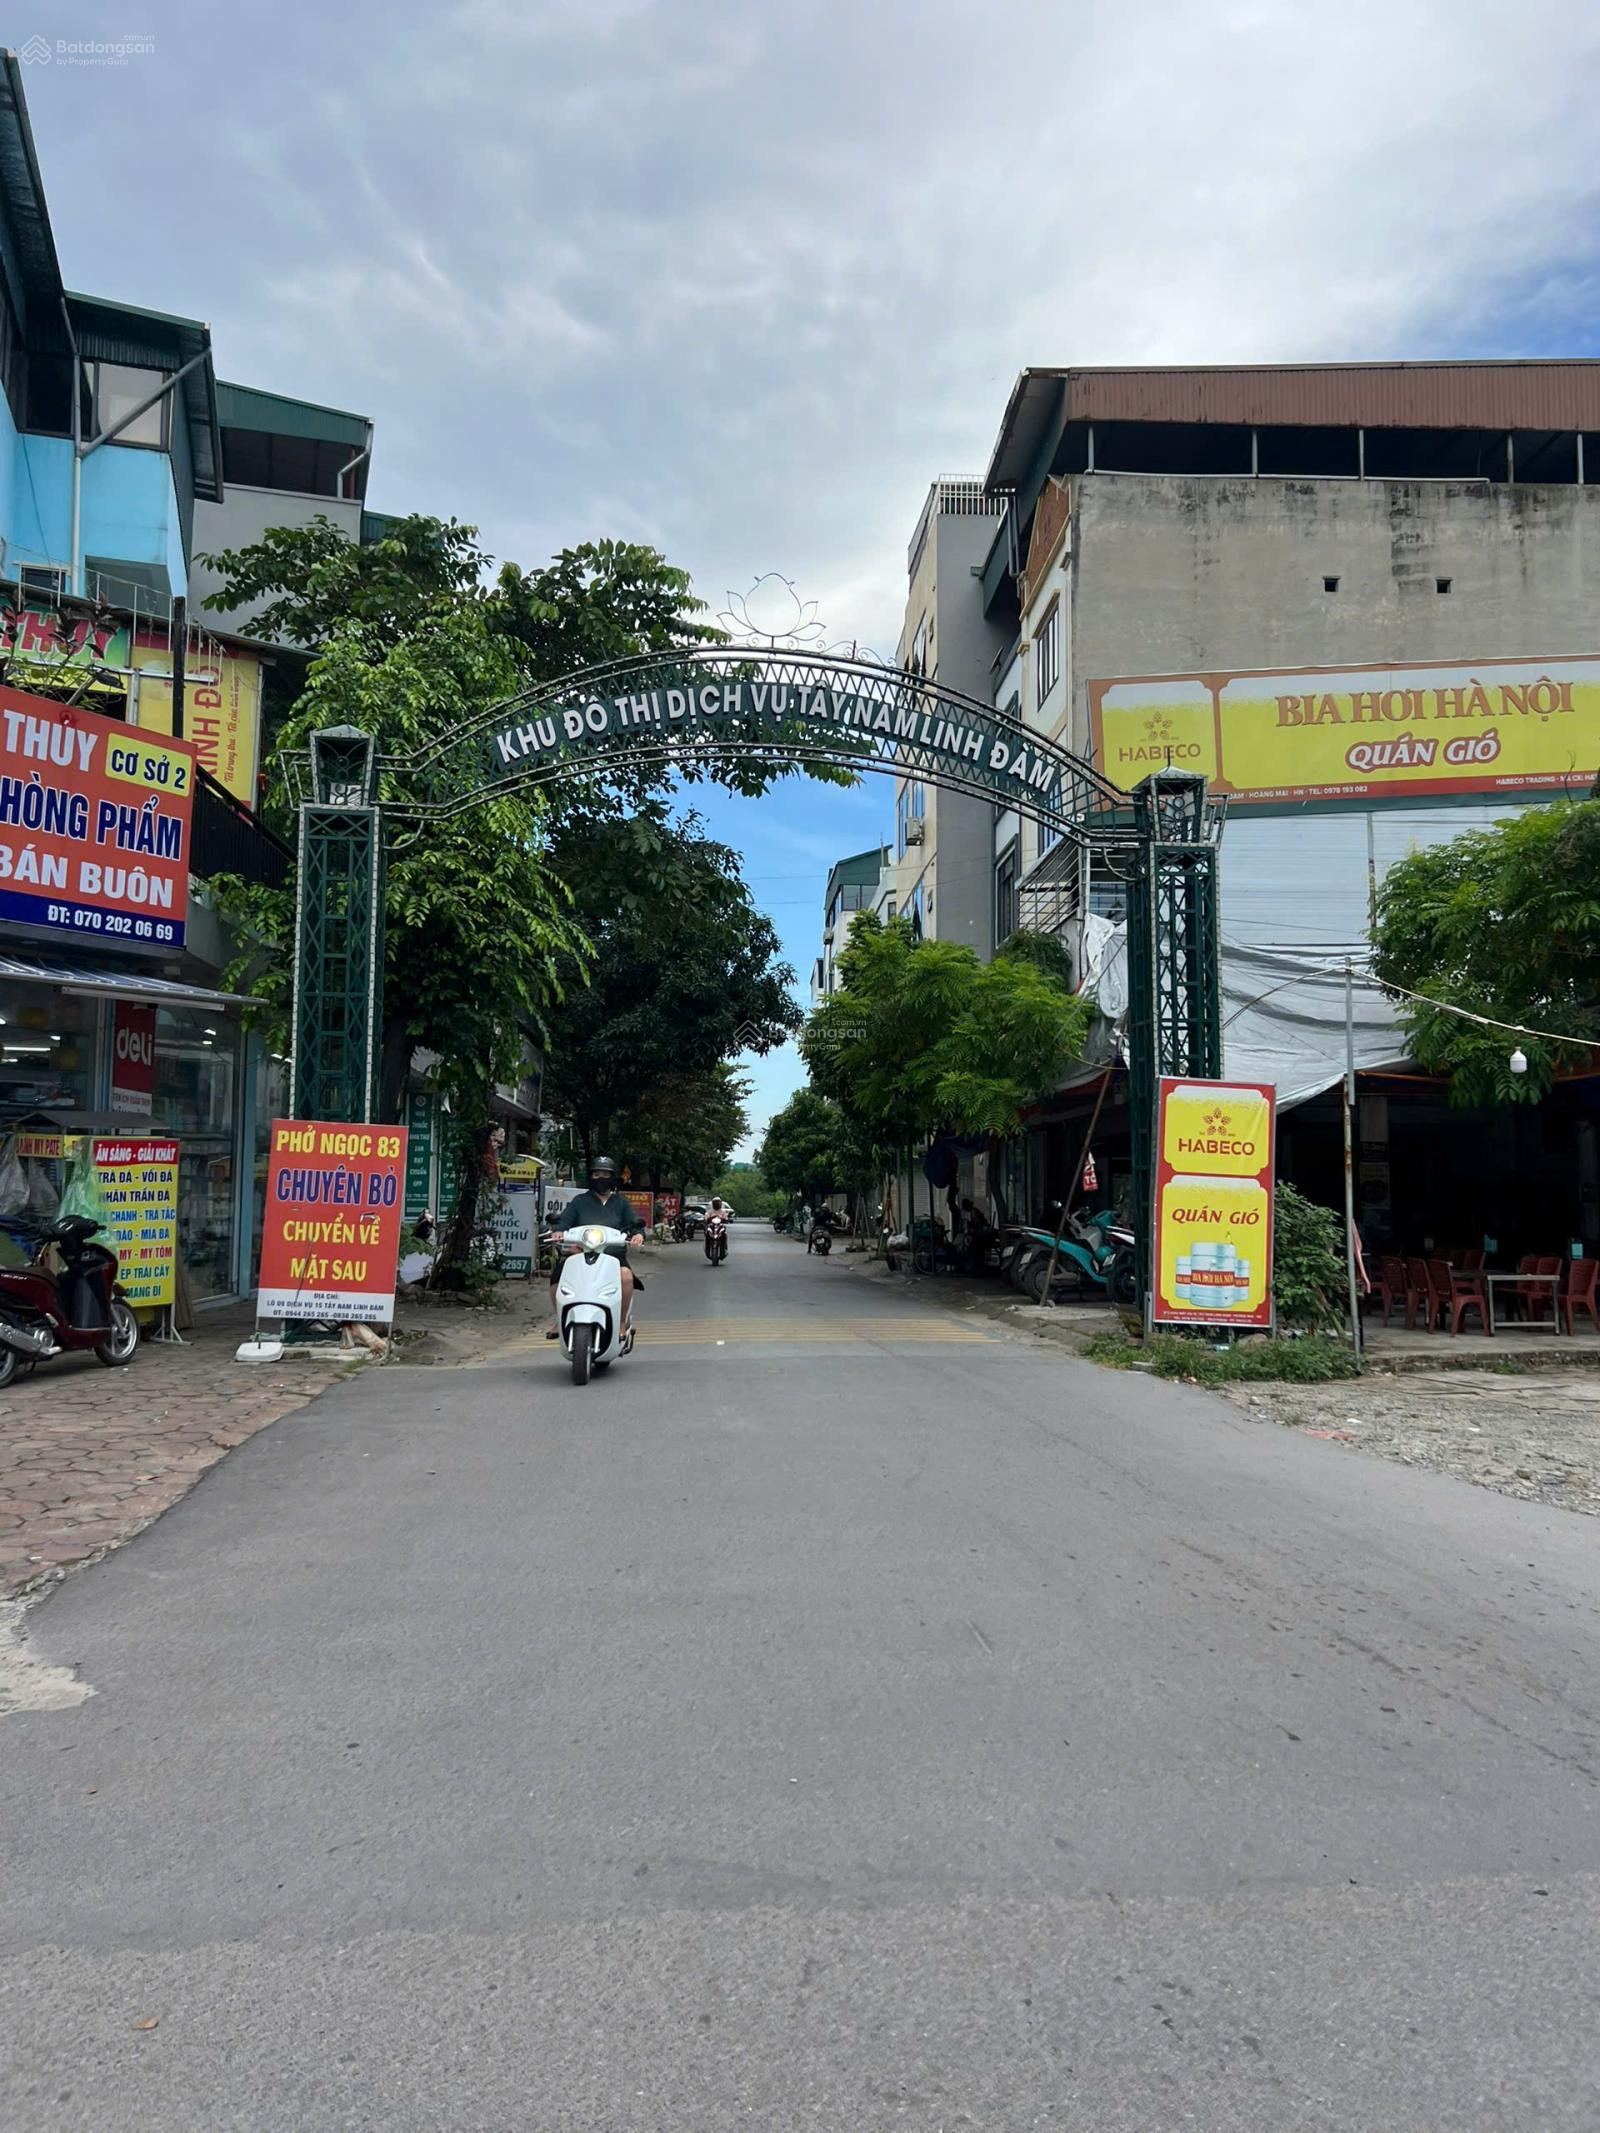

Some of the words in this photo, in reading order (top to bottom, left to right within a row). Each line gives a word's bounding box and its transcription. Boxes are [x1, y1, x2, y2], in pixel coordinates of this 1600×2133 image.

[1275, 693, 1346, 727] BIA
[1348, 688, 1426, 723] HƠI
[1433, 678, 1495, 719] HÀ
[1499, 675, 1575, 722] NỘI
[3, 709, 99, 772] THÚY
[496, 717, 558, 764] KHU
[563, 695, 609, 740] ĐÔ
[614, 691, 662, 730] THỊ
[666, 684, 742, 726] DỊCH
[750, 684, 788, 722] VỤ
[797, 679, 848, 722] TÂY
[852, 700, 919, 740] NAM
[919, 712, 986, 761] LINH
[989, 741, 1057, 793] ĐÀM
[1119, 743, 1201, 762] HABECO
[1346, 732, 1438, 772] QUÁN
[1444, 728, 1500, 764] GIÓ
[111, 748, 140, 777] CƠ
[143, 754, 171, 785] SỞ
[174, 767, 187, 790] 2
[96, 795, 183, 862] PHẨM
[80, 861, 174, 909] BUÔN
[47, 904, 70, 924] ĐT:
[74, 907, 101, 928] 070
[105, 914, 132, 934] 202
[135, 921, 152, 938] 06
[155, 924, 174, 941] 69
[116, 1027, 152, 1066] deli
[109, 1144, 132, 1162] SÁNG
[137, 1142, 154, 1161] GIẢI
[154, 1144, 176, 1162] KHÁT
[276, 1125, 316, 1153] PHỞ
[320, 1133, 372, 1161] NGỌC
[377, 1136, 401, 1158] 83
[1178, 1138, 1255, 1156] HABECO
[119, 1169, 132, 1183] ĐÁ
[159, 1169, 173, 1182] ĐÁ
[277, 1164, 362, 1206] CHUYÊN
[367, 1165, 398, 1207] BÒ
[157, 1188, 170, 1202] ĐÁ
[283, 1212, 355, 1244] CHUYỂN
[1171, 1205, 1223, 1224] QUÁN
[1229, 1208, 1260, 1225] GIÓ
[505, 1230, 529, 1241] THƯ
[290, 1254, 329, 1284] MẶT
[332, 1259, 367, 1282] SAU
